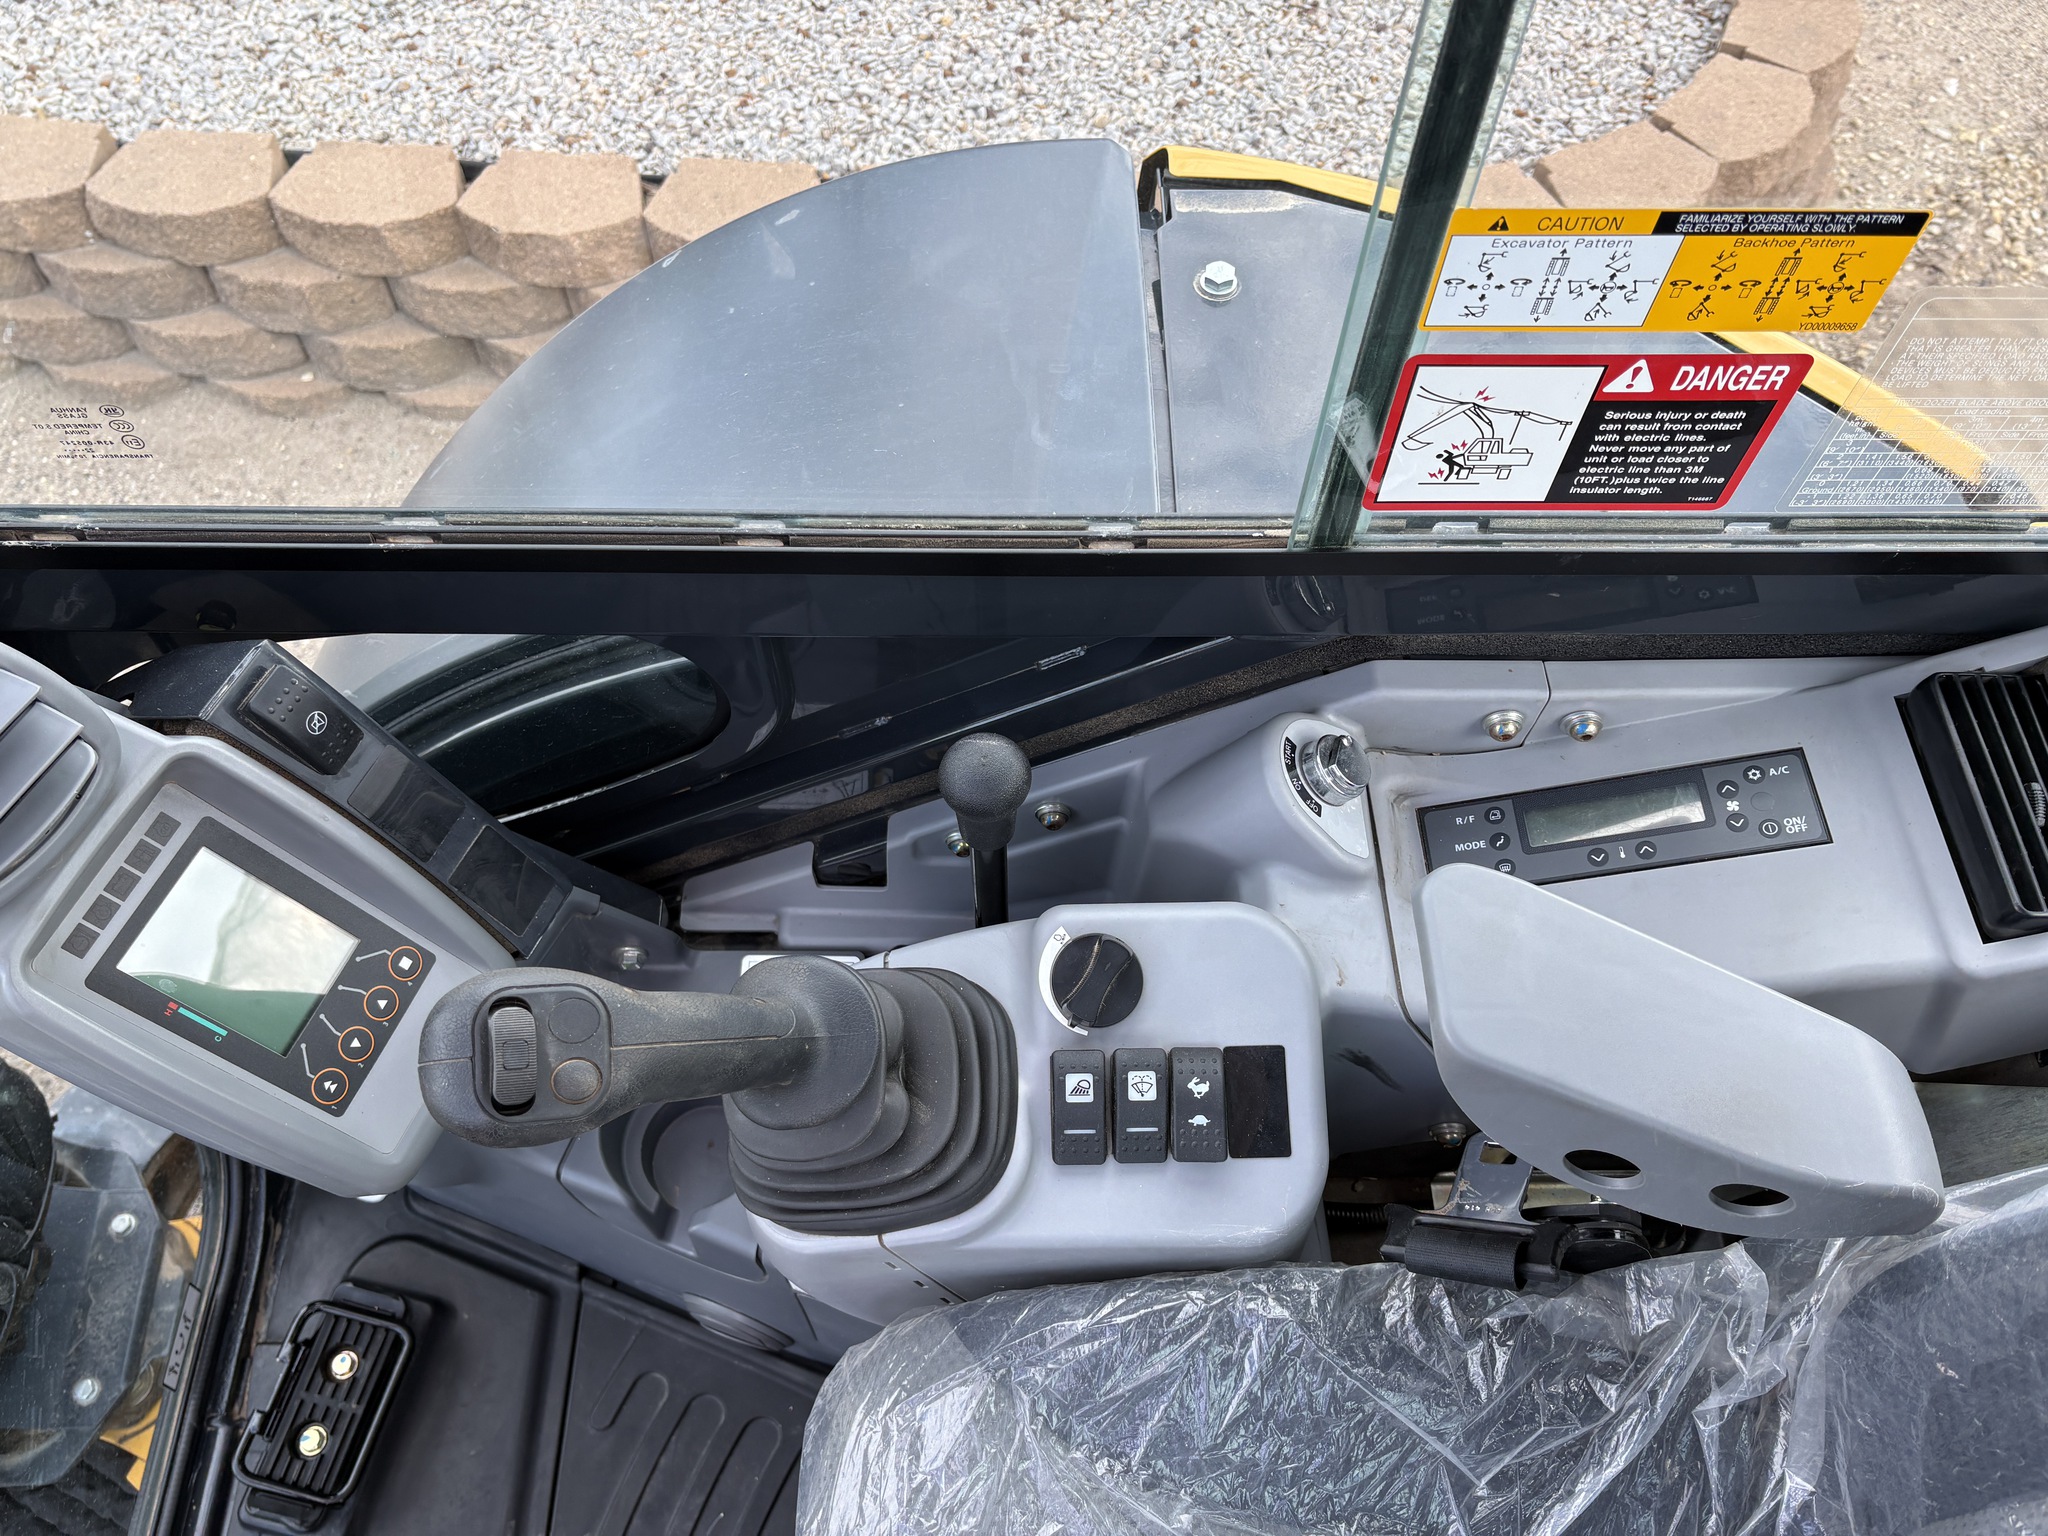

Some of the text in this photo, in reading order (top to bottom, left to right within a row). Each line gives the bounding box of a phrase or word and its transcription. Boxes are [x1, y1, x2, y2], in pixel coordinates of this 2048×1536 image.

[1537, 216, 1624, 231] CAUTION
[1679, 214, 1906, 224] FAMILIARIZE YOURSELF WITH THE PATTERN
[1675, 223, 1857, 232] SELECTED BY OPERATING SLOWLY.
[1491, 238, 1633, 248] Excavator Pattern
[1733, 238, 1856, 248] Backhoe Pattern
[1798, 322, 1858, 331] YD00009658
[1669, 364, 1791, 391] DANGER
[1604, 411, 1653, 420] Serious
[1654, 411, 1691, 422] injury
[1710, 411, 1747, 420] death
[1599, 422, 1743, 432] can result from contact
[1594, 433, 1707, 443] with electric lines.
[1588, 444, 1731, 456] Never move any part of
[1584, 455, 1710, 465] unit or load closer to
[1578, 466, 1705, 476] electric line than 3M
[1643, 476, 1676, 486] twice
[1679, 476, 1700, 486] the
[1701, 476, 1726, 486] line
[1569, 486, 1664, 496] insulator length.
[1284, 741, 1292, 765] START
[1769, 765, 1790, 776] A/C
[1292, 778, 1301, 791] ON
[1305, 799, 1319, 813] OFF
[1455, 815, 1475, 825] R/F
[1783, 816, 1806, 826] ON/
[1786, 823, 1808, 834] OFF
[1454, 840, 1487, 852] MODE
[164, 1008, 173, 1016] H
